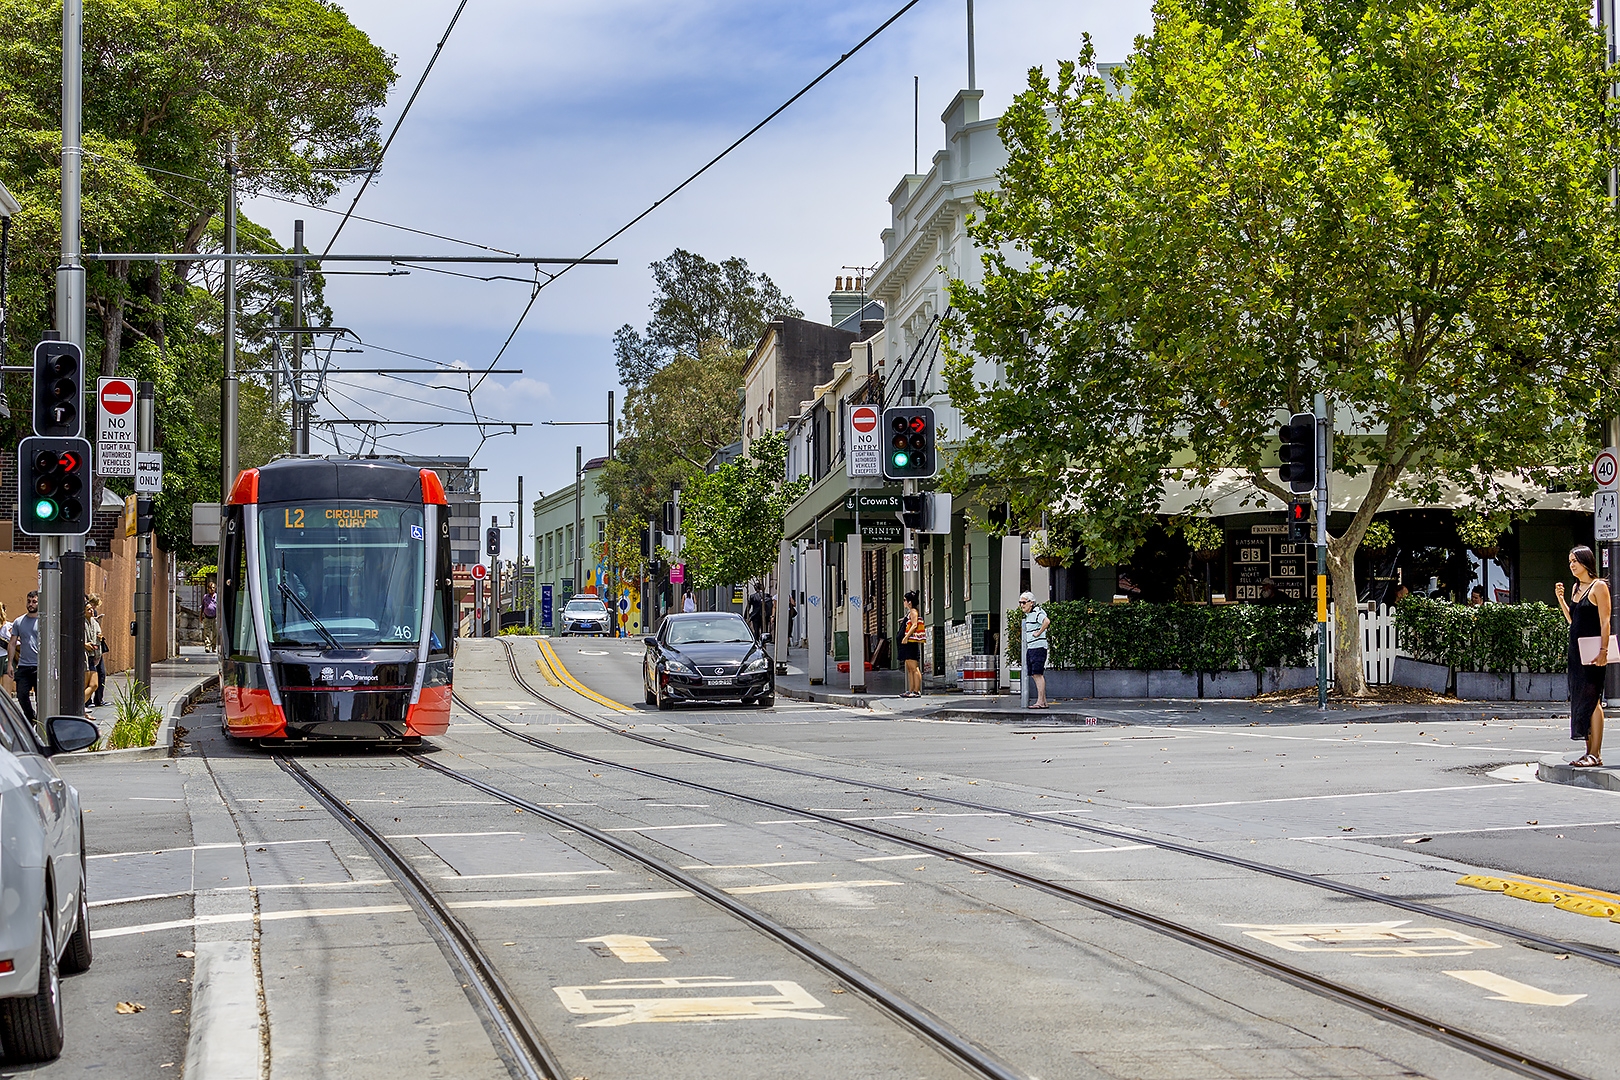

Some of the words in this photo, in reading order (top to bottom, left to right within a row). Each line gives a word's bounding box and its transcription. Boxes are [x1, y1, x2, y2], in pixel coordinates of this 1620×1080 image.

[108, 418, 126, 429] NO
[101, 431, 132, 440] ENTRY
[858, 434, 872, 443] NO
[101, 443, 117, 451] LIGHT
[119, 443, 132, 451] RAIL
[102, 466, 131, 474] EXCEPTED
[1599, 461, 1613, 476] 40
[139, 475, 159, 486] ONLY
[860, 496, 888, 505] Crown
[889, 496, 899, 505] St
[284, 508, 305, 528] L2
[325, 509, 379, 519] CIRCULAR
[1282, 545, 1295, 553] 91
[1242, 550, 1260, 560] 63
[476, 567, 482, 577] L
[1282, 567, 1295, 575] 04
[394, 625, 412, 639] 46
[1086, 717, 1097, 725] HR
